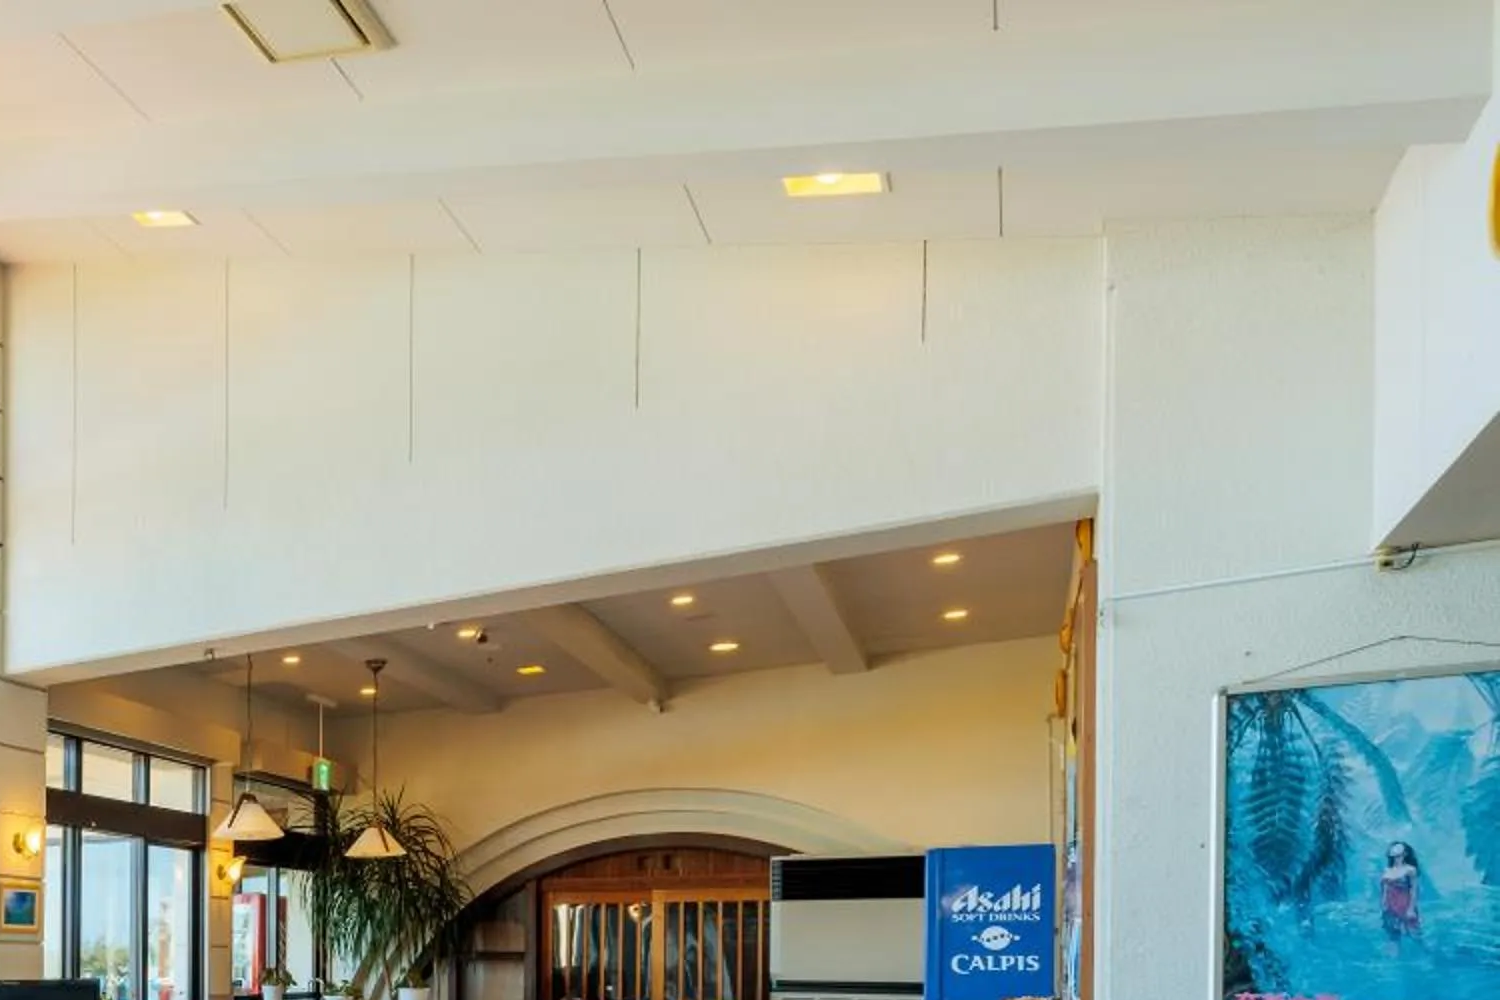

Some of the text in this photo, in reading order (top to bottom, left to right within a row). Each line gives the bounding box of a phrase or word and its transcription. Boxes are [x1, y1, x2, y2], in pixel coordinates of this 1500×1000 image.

[951, 883, 1042, 912] Asahi
[952, 912, 1041, 922] SOFT DRINKS
[951, 954, 1040, 975] CALPIS
